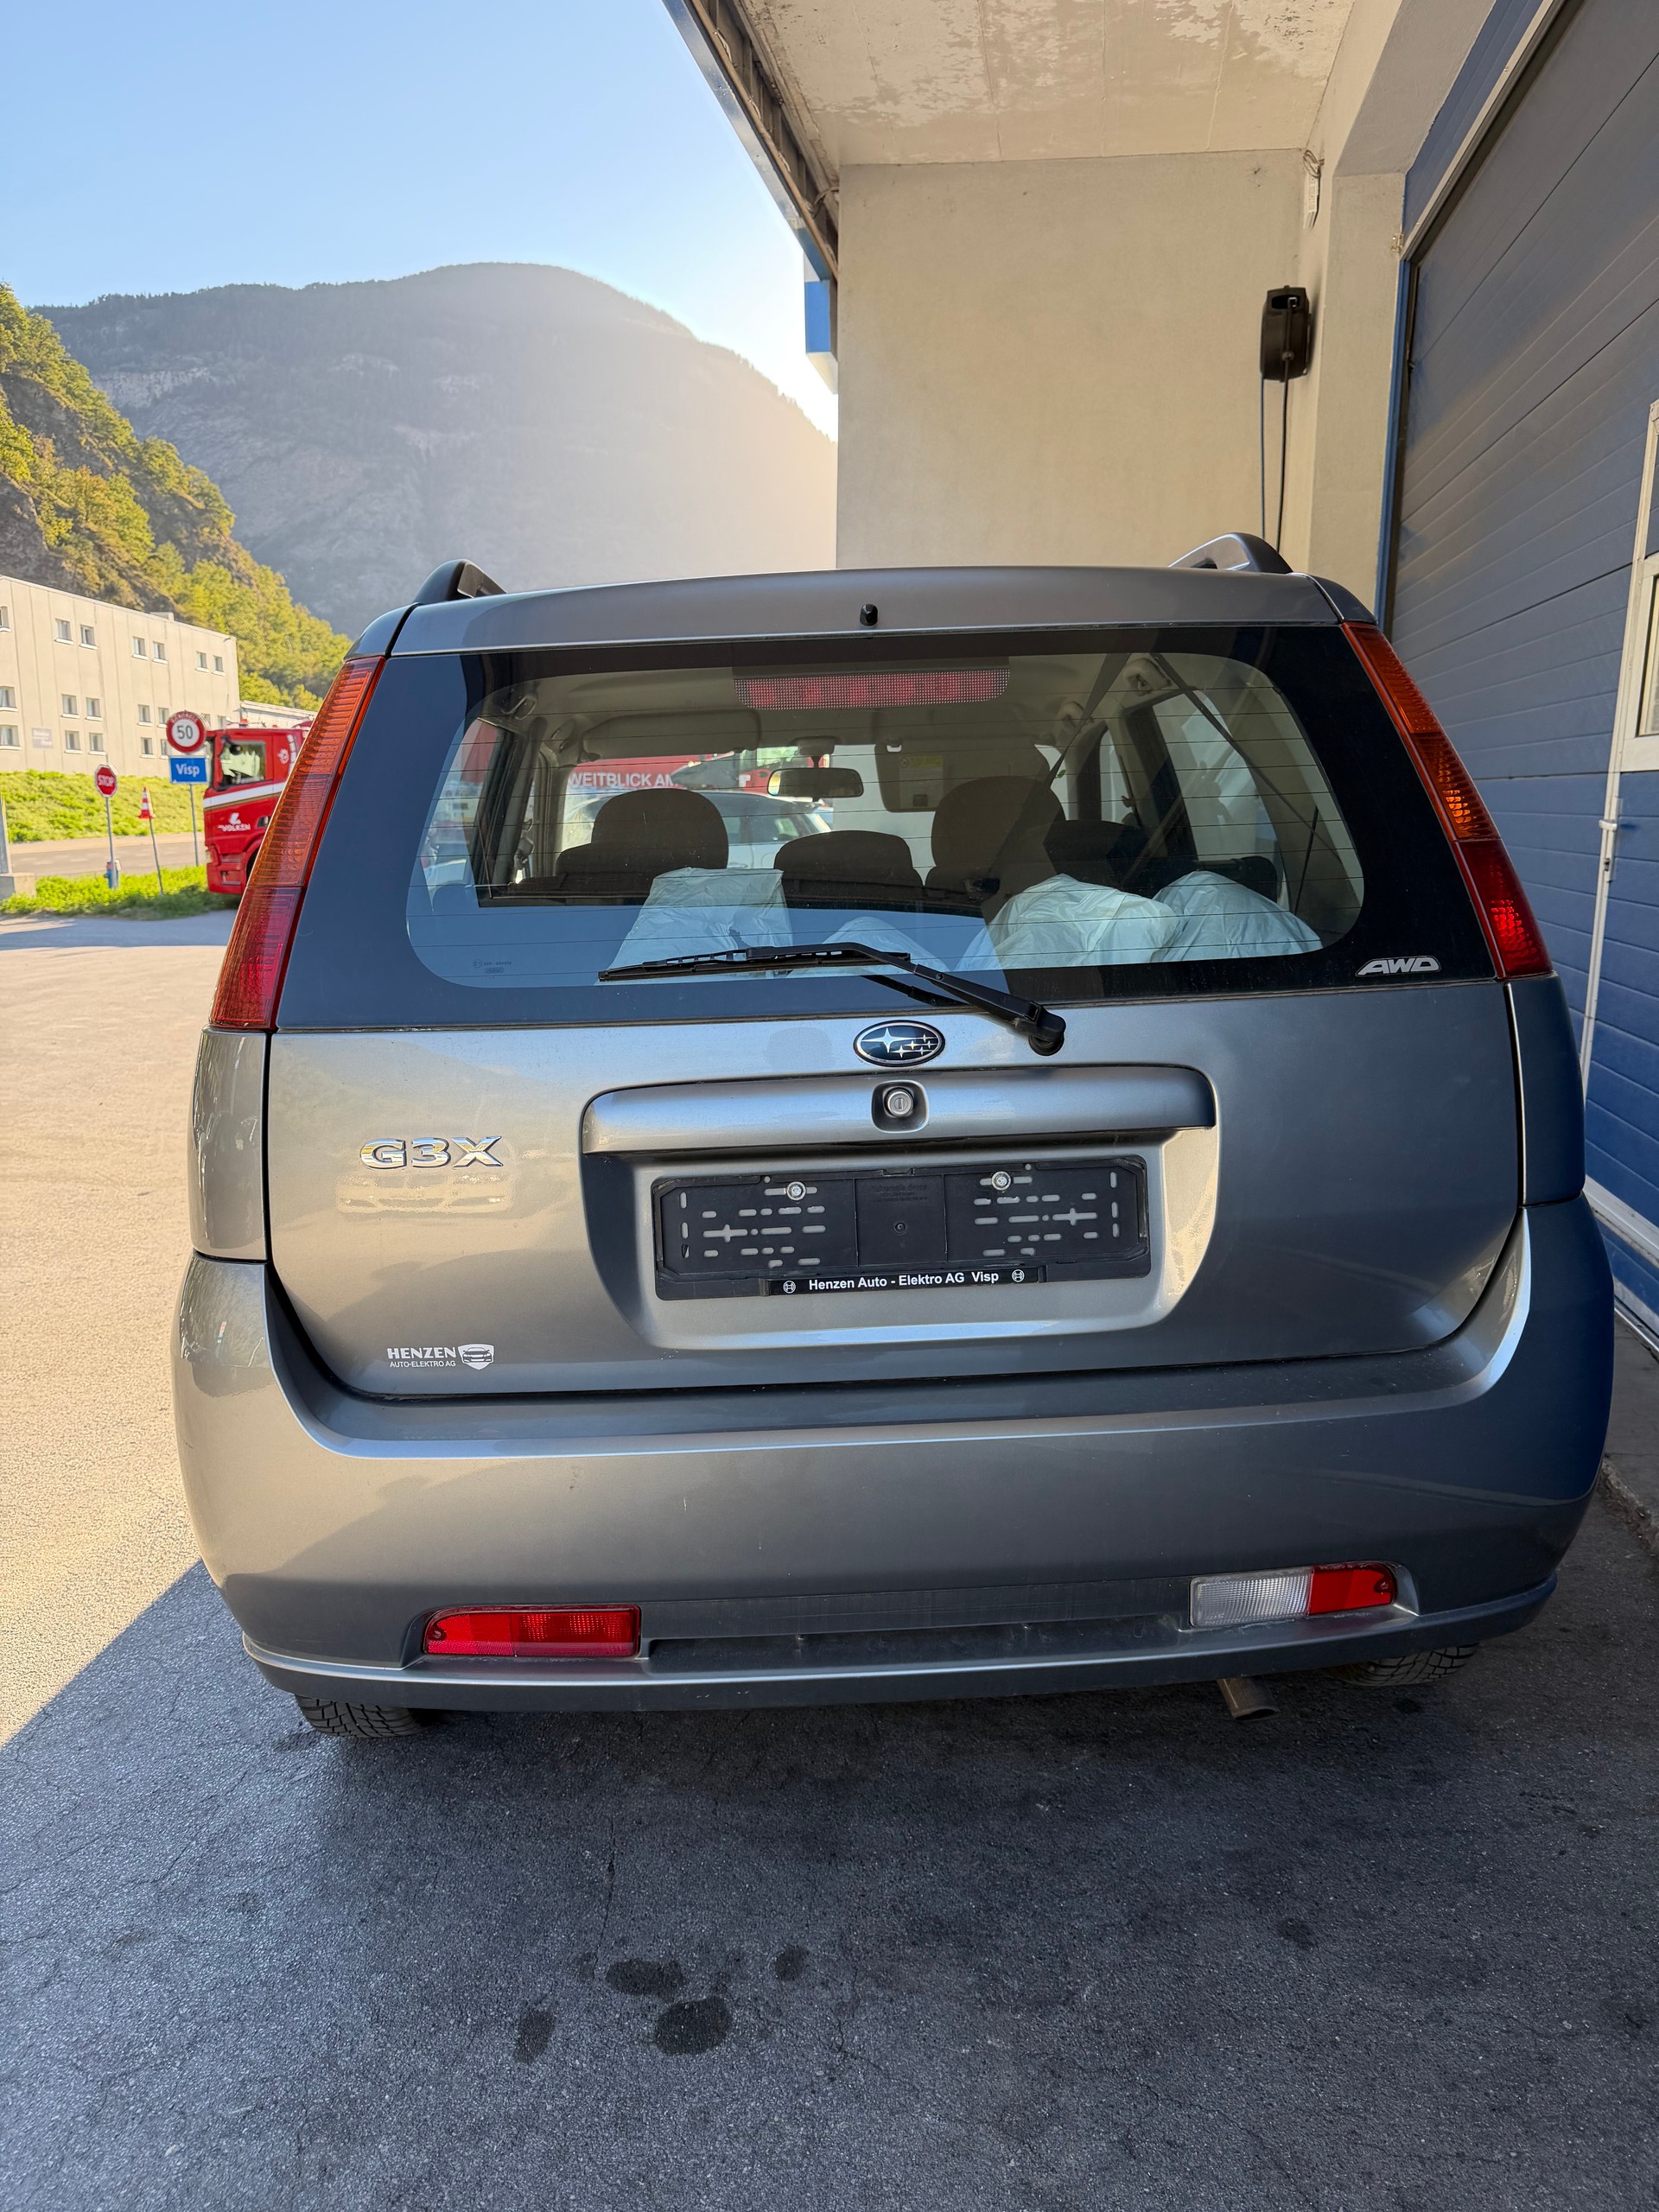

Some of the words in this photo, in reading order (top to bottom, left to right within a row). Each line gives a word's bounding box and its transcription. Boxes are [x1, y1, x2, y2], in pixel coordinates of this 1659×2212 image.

[177, 725, 193, 739] 50
[175, 763, 200, 777] Visp
[98, 775, 115, 786] STOP
[569, 772, 651, 787] WEITBLICK
[1357, 957, 1440, 976] AWD
[359, 1135, 503, 1169] G3X
[809, 1279, 855, 1291] Henzen
[858, 1276, 887, 1288] Auto
[899, 1274, 943, 1286] Elektro
[945, 1272, 965, 1283] AG
[971, 1271, 999, 1284] Visp
[387, 1347, 456, 1359] HENZEN
